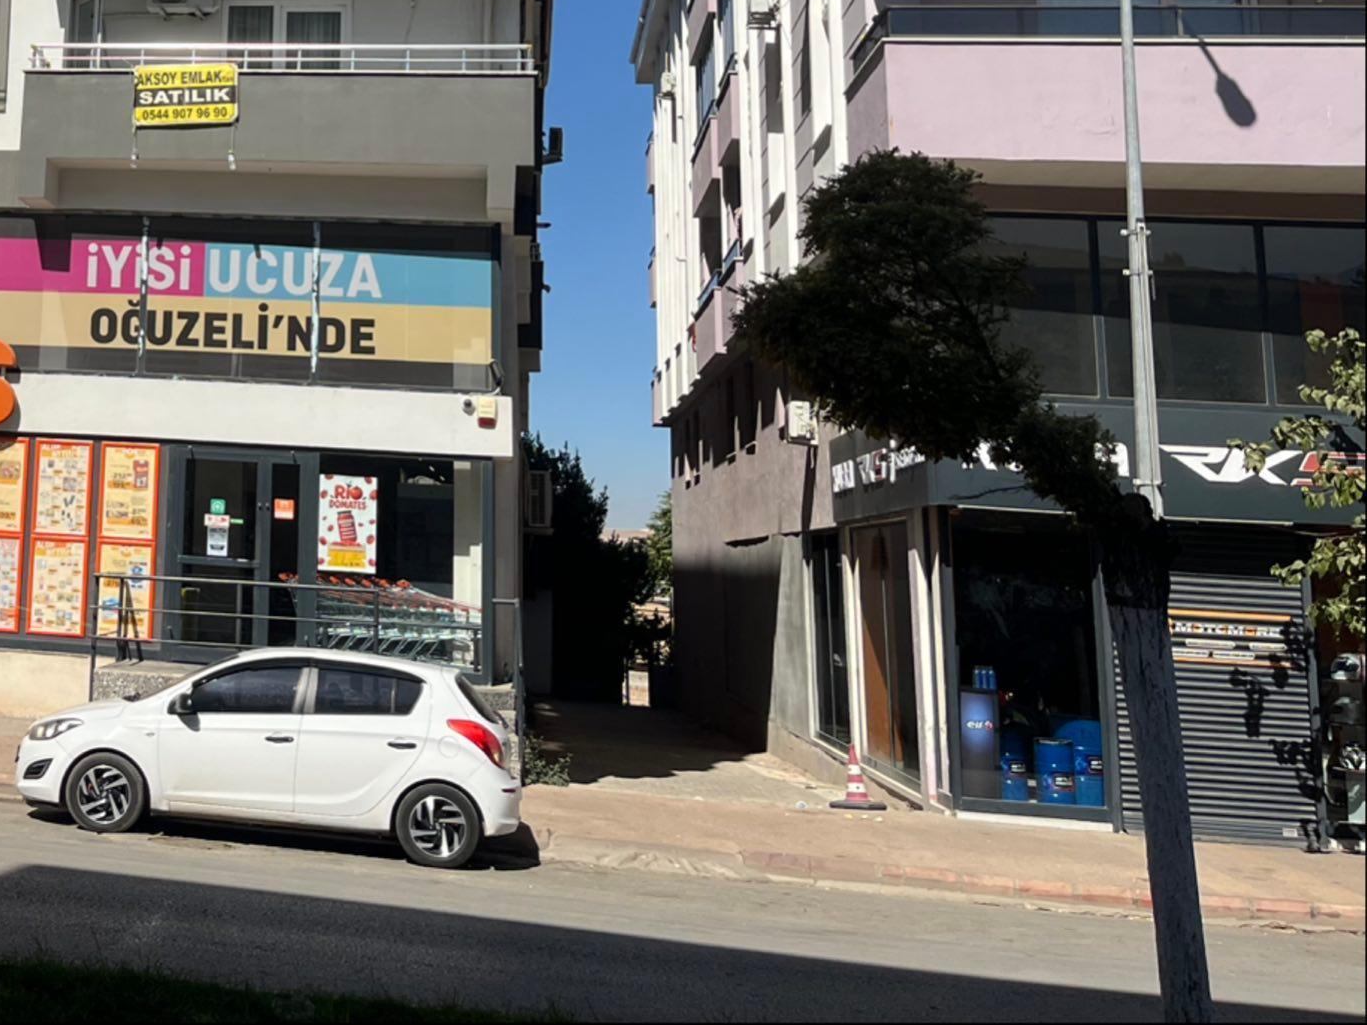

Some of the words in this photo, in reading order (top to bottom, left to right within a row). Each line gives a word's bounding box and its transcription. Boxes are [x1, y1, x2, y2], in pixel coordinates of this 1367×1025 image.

[136, 71, 178, 86] AKSOY
[181, 69, 222, 84] EMLAK
[139, 87, 231, 104] SATILIK
[142, 109, 169, 120] 0544
[172, 108, 193, 119] 907
[196, 107, 210, 118] 96
[213, 106, 227, 117] 90
[208, 247, 383, 299] UCUZA
[328, 499, 367, 510] DOMATES
